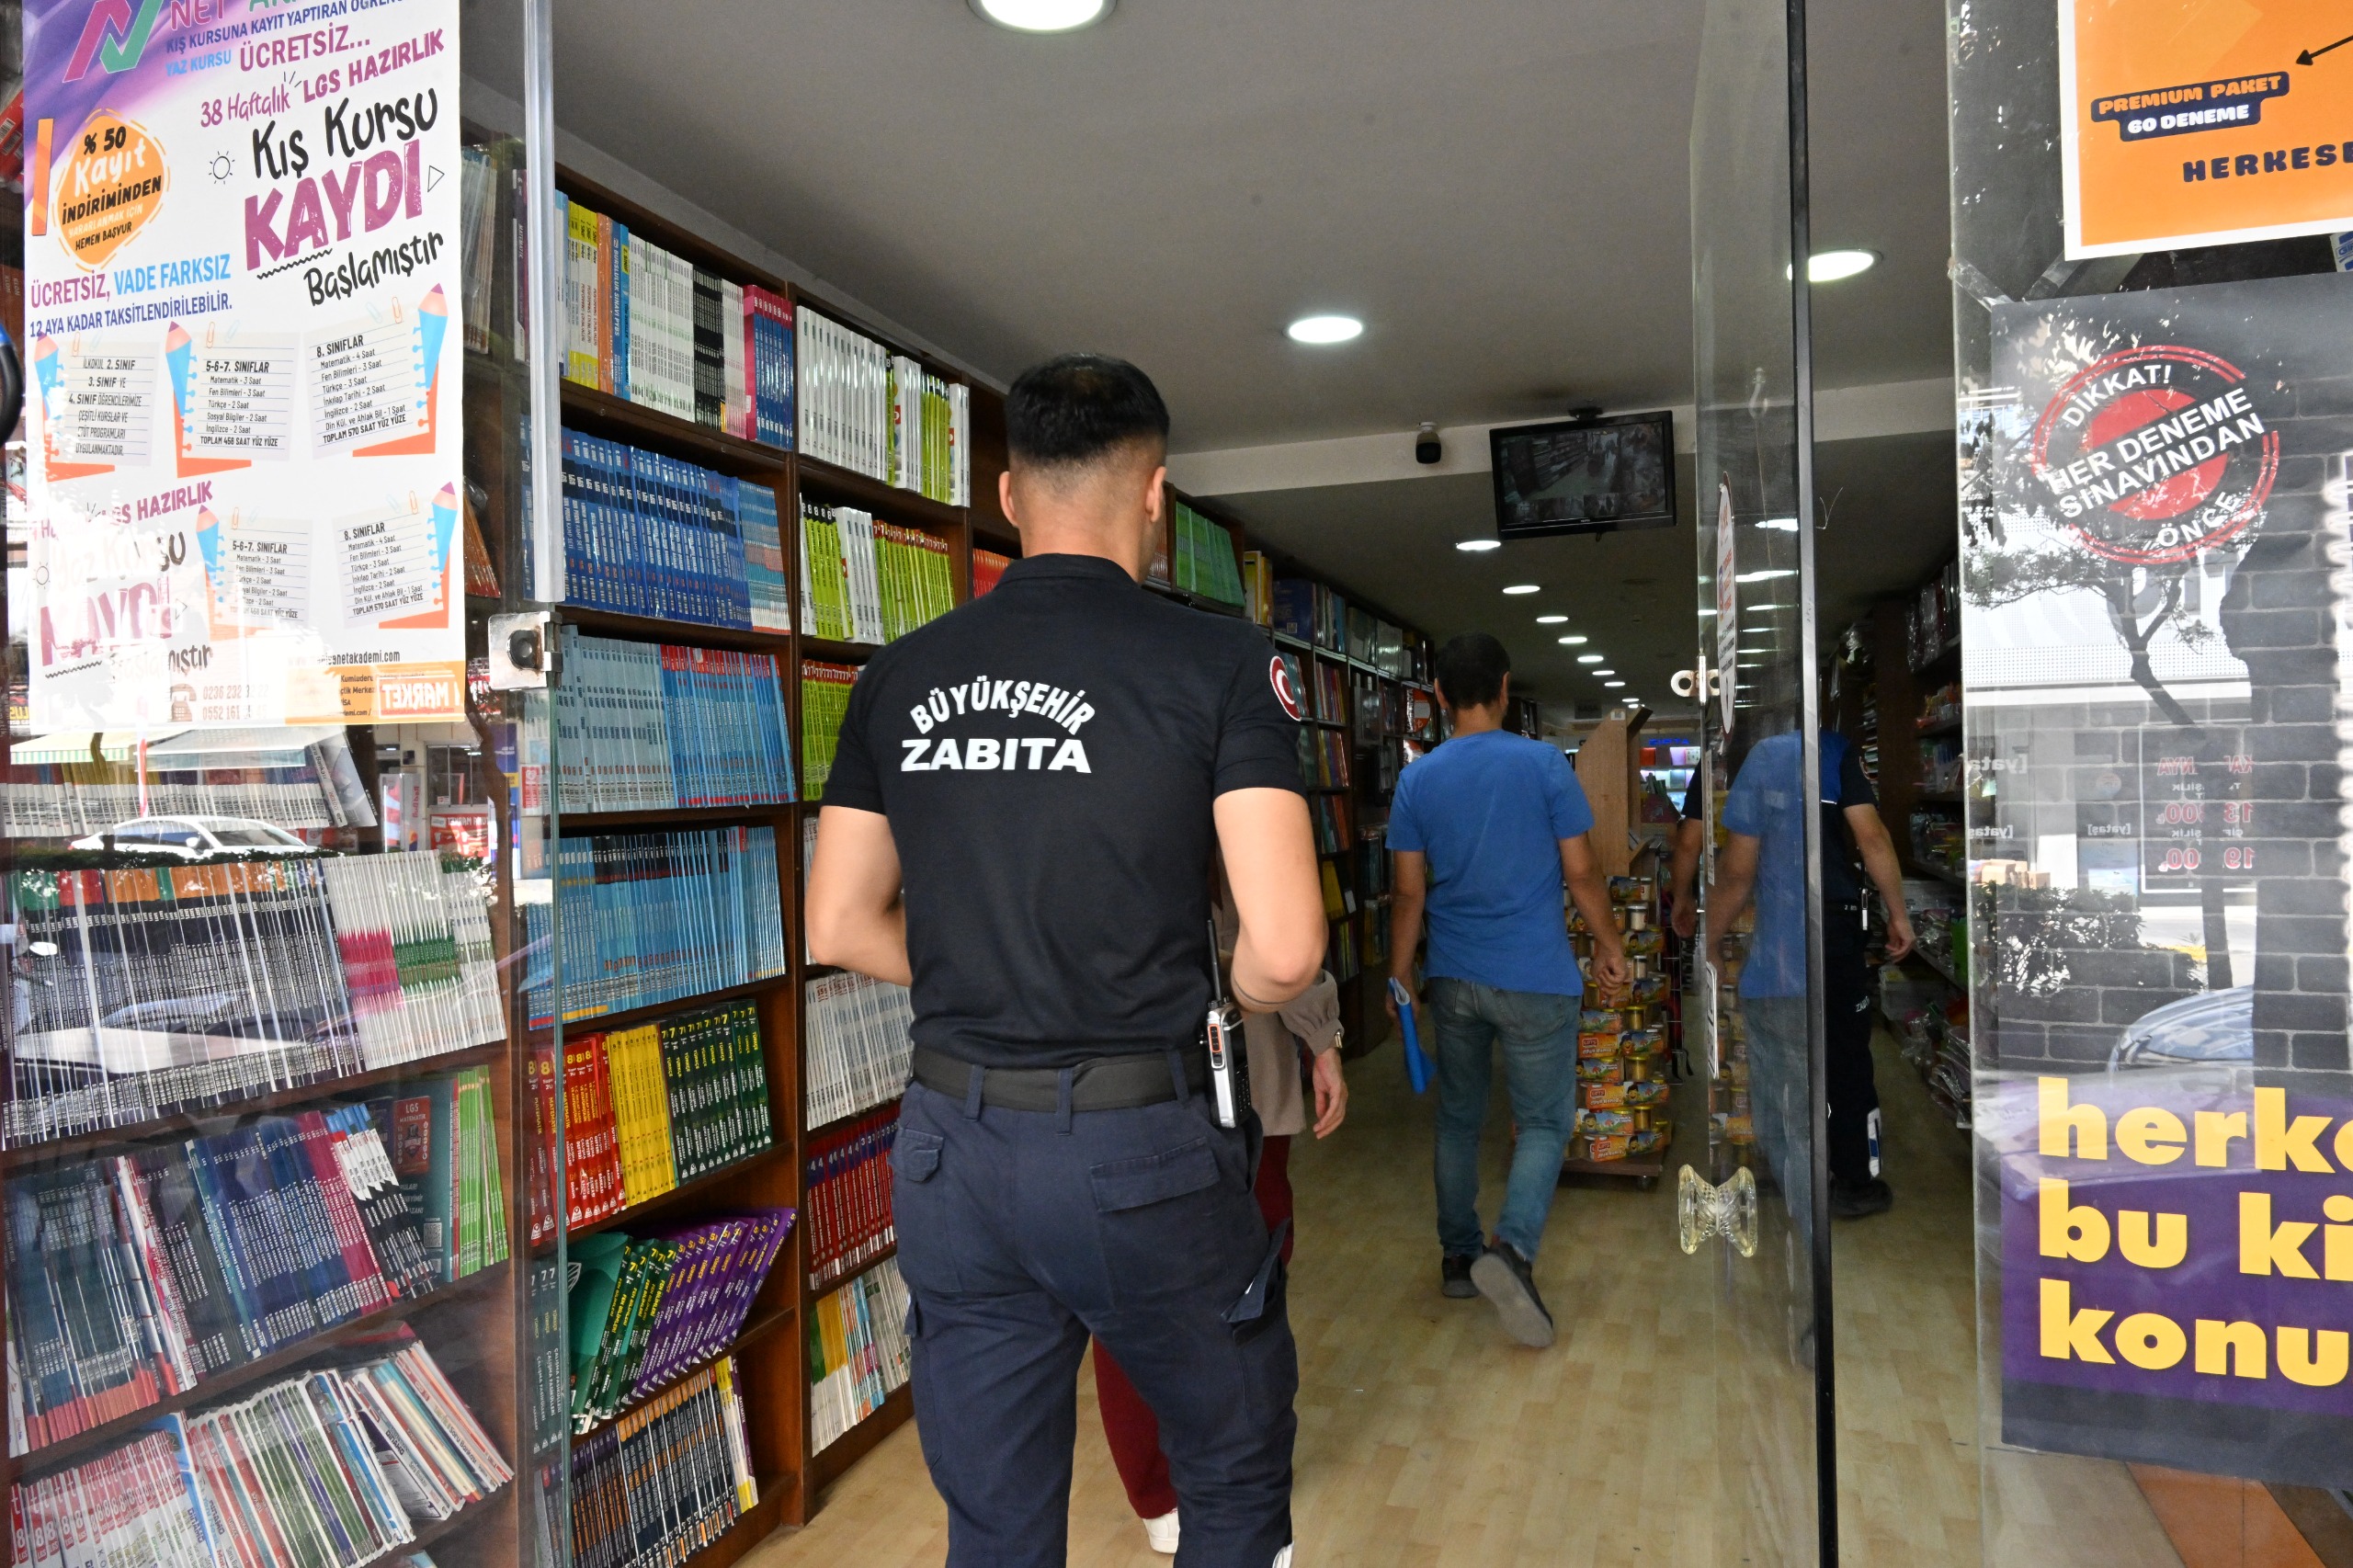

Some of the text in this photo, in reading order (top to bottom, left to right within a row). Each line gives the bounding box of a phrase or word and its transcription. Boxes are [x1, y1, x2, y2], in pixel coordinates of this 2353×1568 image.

[166, 36, 187, 55] KIŞ
[189, 26, 248, 48] KURSUNA
[251, 14, 285, 35] KAYIT
[288, 0, 347, 28] YAPTIRAN
[165, 22, 370, 76] YAZ KURSU ÜCRETSİZ...
[200, 28, 445, 128] 38 Haftalık LGS HAZIRLIK
[2098, 74, 2281, 115] PREMIUM PAKET
[253, 88, 438, 179] Kış Kursu
[2127, 105, 2249, 134] 60 DENEME
[104, 126, 127, 152] 50
[74, 138, 146, 198] Kayıt
[62, 175, 162, 225] İNDİRİMİNDEN
[245, 139, 422, 271] KAYDI
[68, 202, 142, 239] YARARLANMAK İÇİN
[75, 222, 132, 252] HEMEN BAŞVUR
[30, 253, 232, 309] ÜCRETSİZ, VADE FARKSIZ
[304, 232, 445, 306] Başlamıştır
[612, 249, 621, 291] BURSLULUK
[29, 290, 233, 337] 12 AYA KADAR TAKSİTLENDİRİLEBİLİR.
[316, 335, 364, 358] 8. SINIFLAR
[321, 356, 350, 369] Matematik
[362, 348, 375, 358] Saat
[84, 358, 135, 370] İLKOKUL 2. SINIF
[206, 360, 269, 373] 5-6-7. SINIFLAR
[322, 373, 332, 383] Fen
[334, 365, 357, 379] Bilimleri
[369, 359, 381, 369] Saat
[88, 377, 126, 388] 3. SINIF VE
[209, 388, 219, 396] Fen
[221, 388, 242, 397] Bilimleri
[253, 389, 265, 397] Saat
[210, 376, 238, 384] Matematik
[323, 382, 342, 393] Türkçe
[354, 376, 367, 386] Saat
[345, 391, 360, 401] Tarihi
[372, 384, 385, 394] Saat
[69, 392, 142, 406] 4. SINIF ÖĞRENCİLERİMİZE
[209, 400, 226, 409] Türkçe
[237, 401, 249, 409] Saat
[324, 406, 348, 419] İngilizce
[359, 400, 372, 410] Saat
[2061, 364, 2171, 427] DİKKAT!
[97, 411, 120, 422] KURSLAR
[122, 413, 128, 423] VE
[206, 423, 228, 434] İngilizce
[239, 426, 250, 434] Saat
[207, 413, 224, 422] Sosyal
[226, 413, 244, 423] Bilgiler
[255, 414, 267, 422] Saat
[323, 414, 406, 444] TOPLAM 570 SAAT YÜZ YÜZE
[326, 422, 335, 431] Din
[358, 412, 373, 424] Ahlak
[392, 404, 405, 415] Saat
[91, 426, 125, 439] PROGRAMLARI
[200, 436, 222, 445] TOPLAM
[236, 437, 250, 446] SAAT
[252, 436, 262, 446] YÜZ
[264, 436, 278, 447] YÜZE
[2047, 388, 2252, 496] HER DENEME
[2059, 413, 2266, 519] SINAVINDAN
[137, 480, 213, 521] HAZIRLIK
[344, 522, 385, 540] 8. SINIFLAR
[2157, 491, 2240, 549] ÖNCE
[233, 540, 287, 554] 5-6-7. SINIFLAR
[352, 592, 424, 616] TOPLAM 570 SAAT YÜZ YÜZE
[910, 675, 1096, 734] BÜYÜKŞEHİR
[901, 737, 1091, 773] ZABITA
[406, 1103, 419, 1113] LGS
[2038, 1178, 2188, 1269] bu
